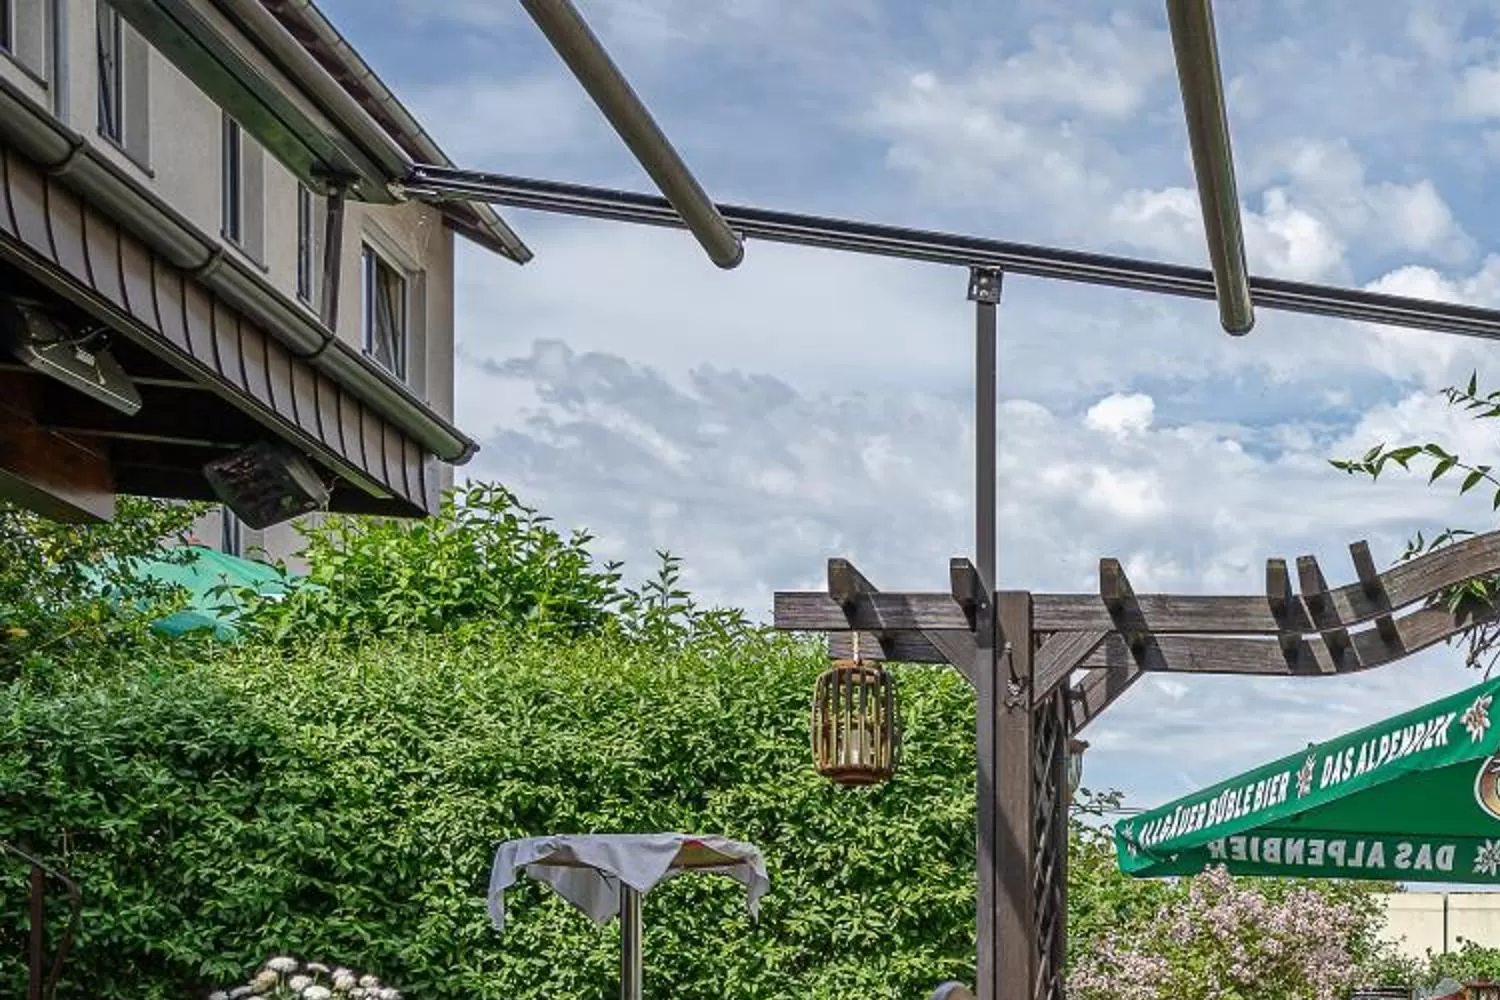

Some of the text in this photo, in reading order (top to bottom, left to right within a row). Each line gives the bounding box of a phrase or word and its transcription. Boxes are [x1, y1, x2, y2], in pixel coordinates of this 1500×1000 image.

[1138, 802, 1207, 849] ALLGÄUER
[1206, 787, 1251, 827] BÜBLE
[1252, 771, 1289, 811] BIER
[1320, 747, 1354, 789] DAS
